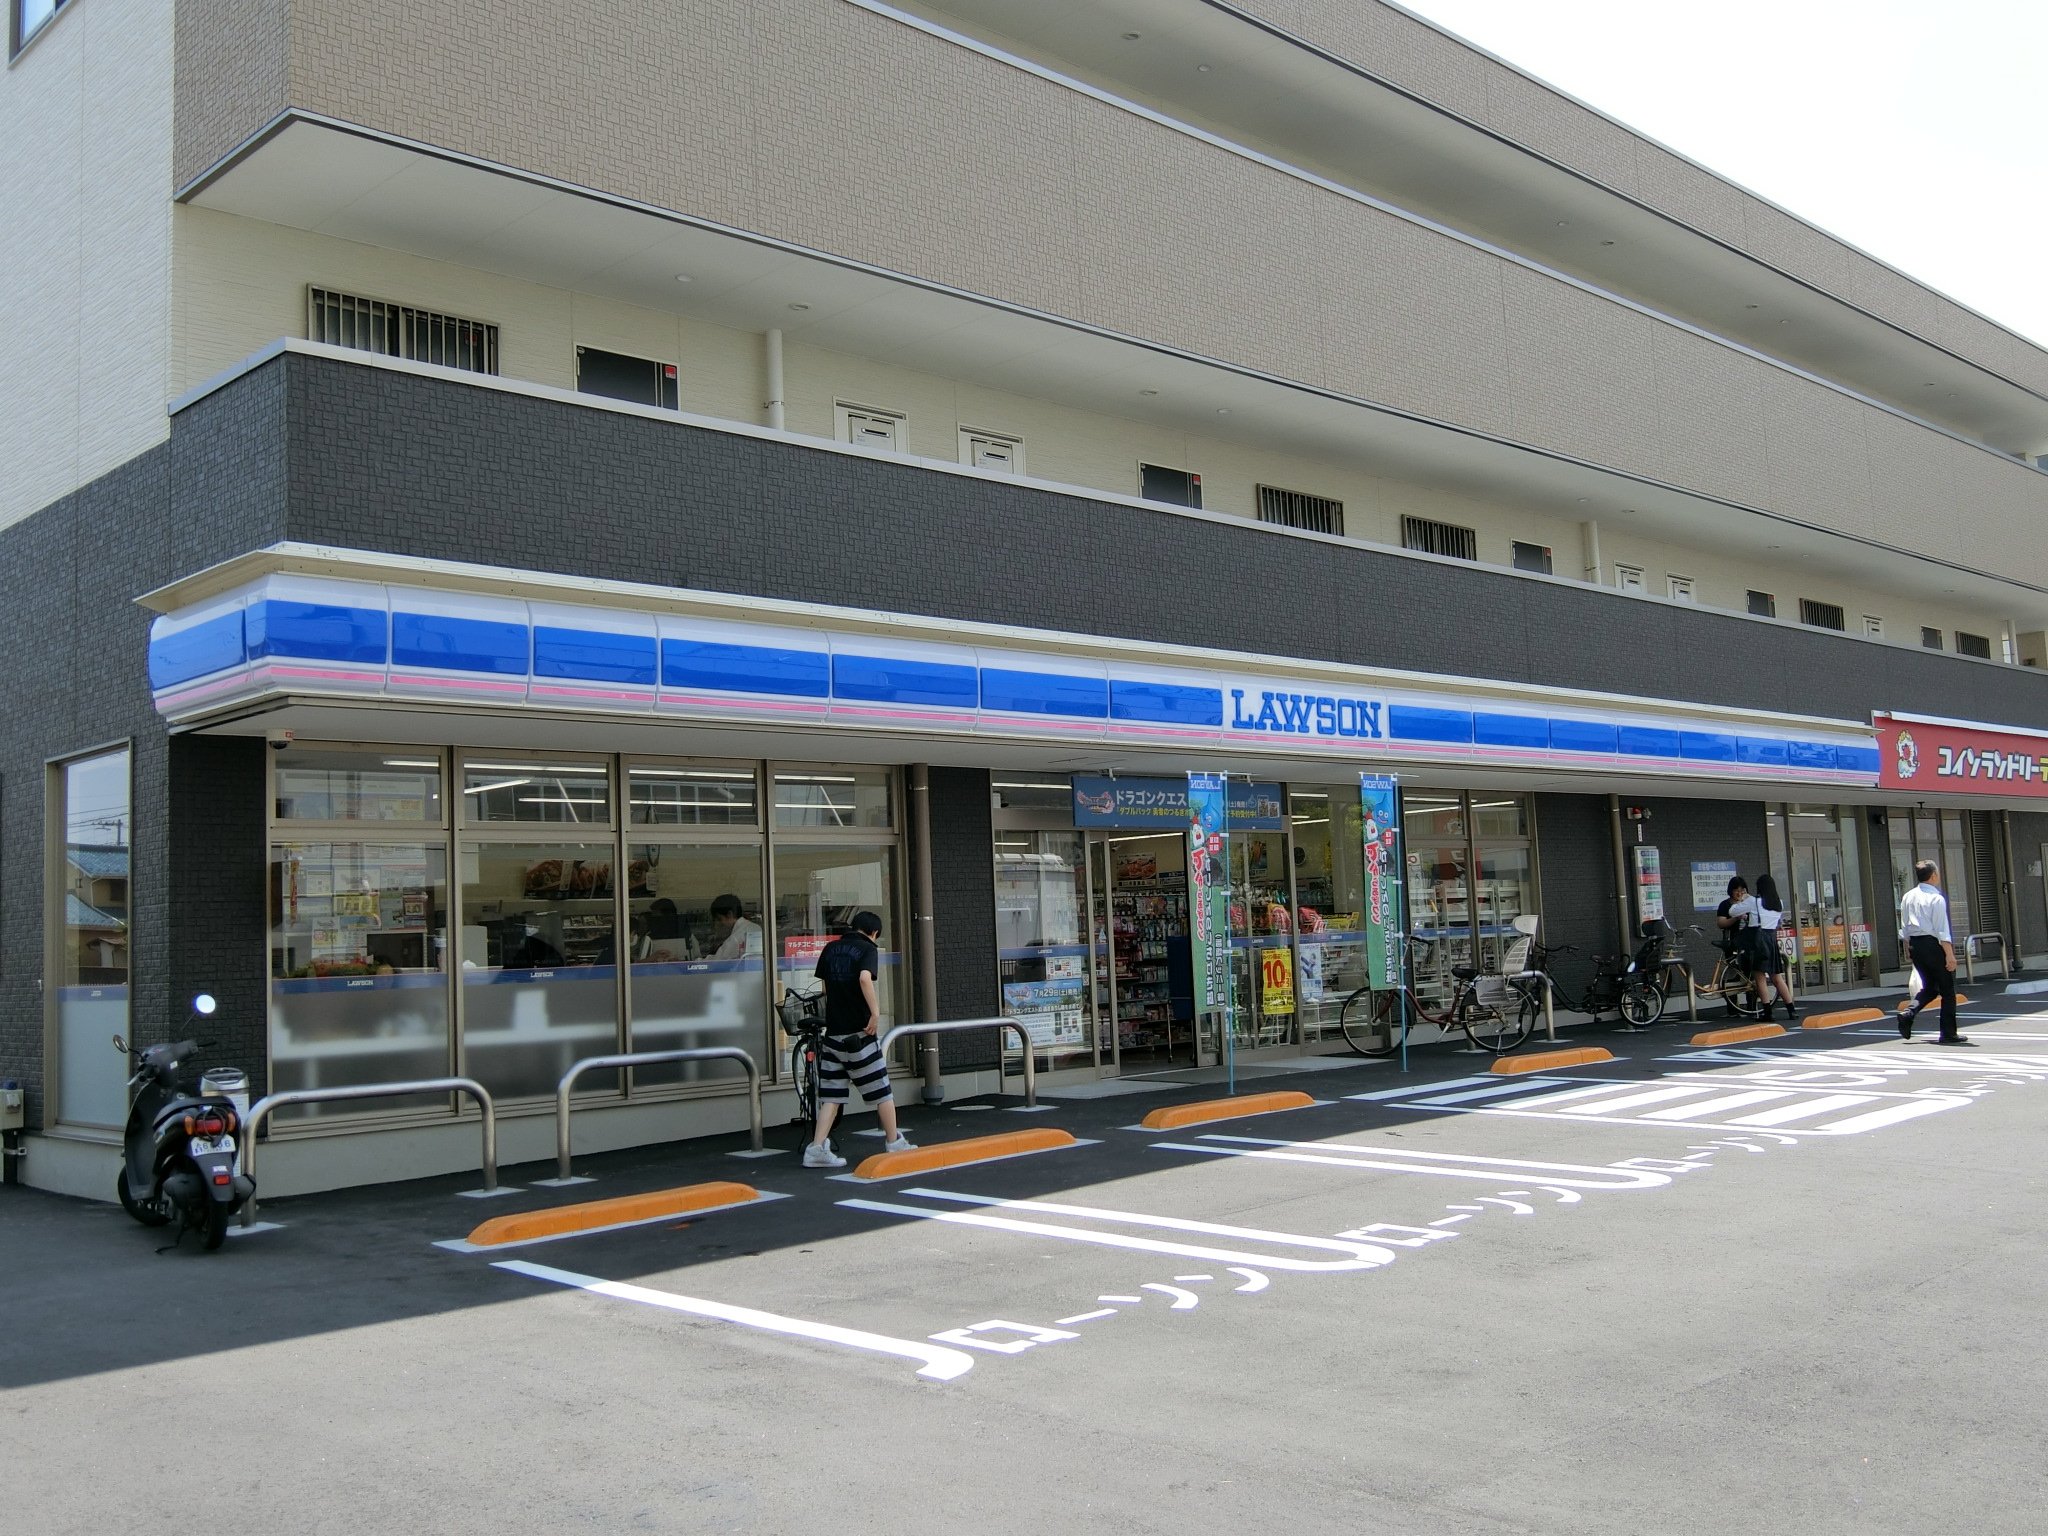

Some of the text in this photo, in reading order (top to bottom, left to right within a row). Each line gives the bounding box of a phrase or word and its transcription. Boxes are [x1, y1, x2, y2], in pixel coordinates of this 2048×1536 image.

[1231, 688, 1382, 738] LAWSON
[1115, 789, 1187, 806] ドラゴンクエス
[1605, 1133, 1799, 1172] ローソン
[1333, 1186, 1582, 1247] ローソン
[927, 1266, 1270, 1354] ローソン
